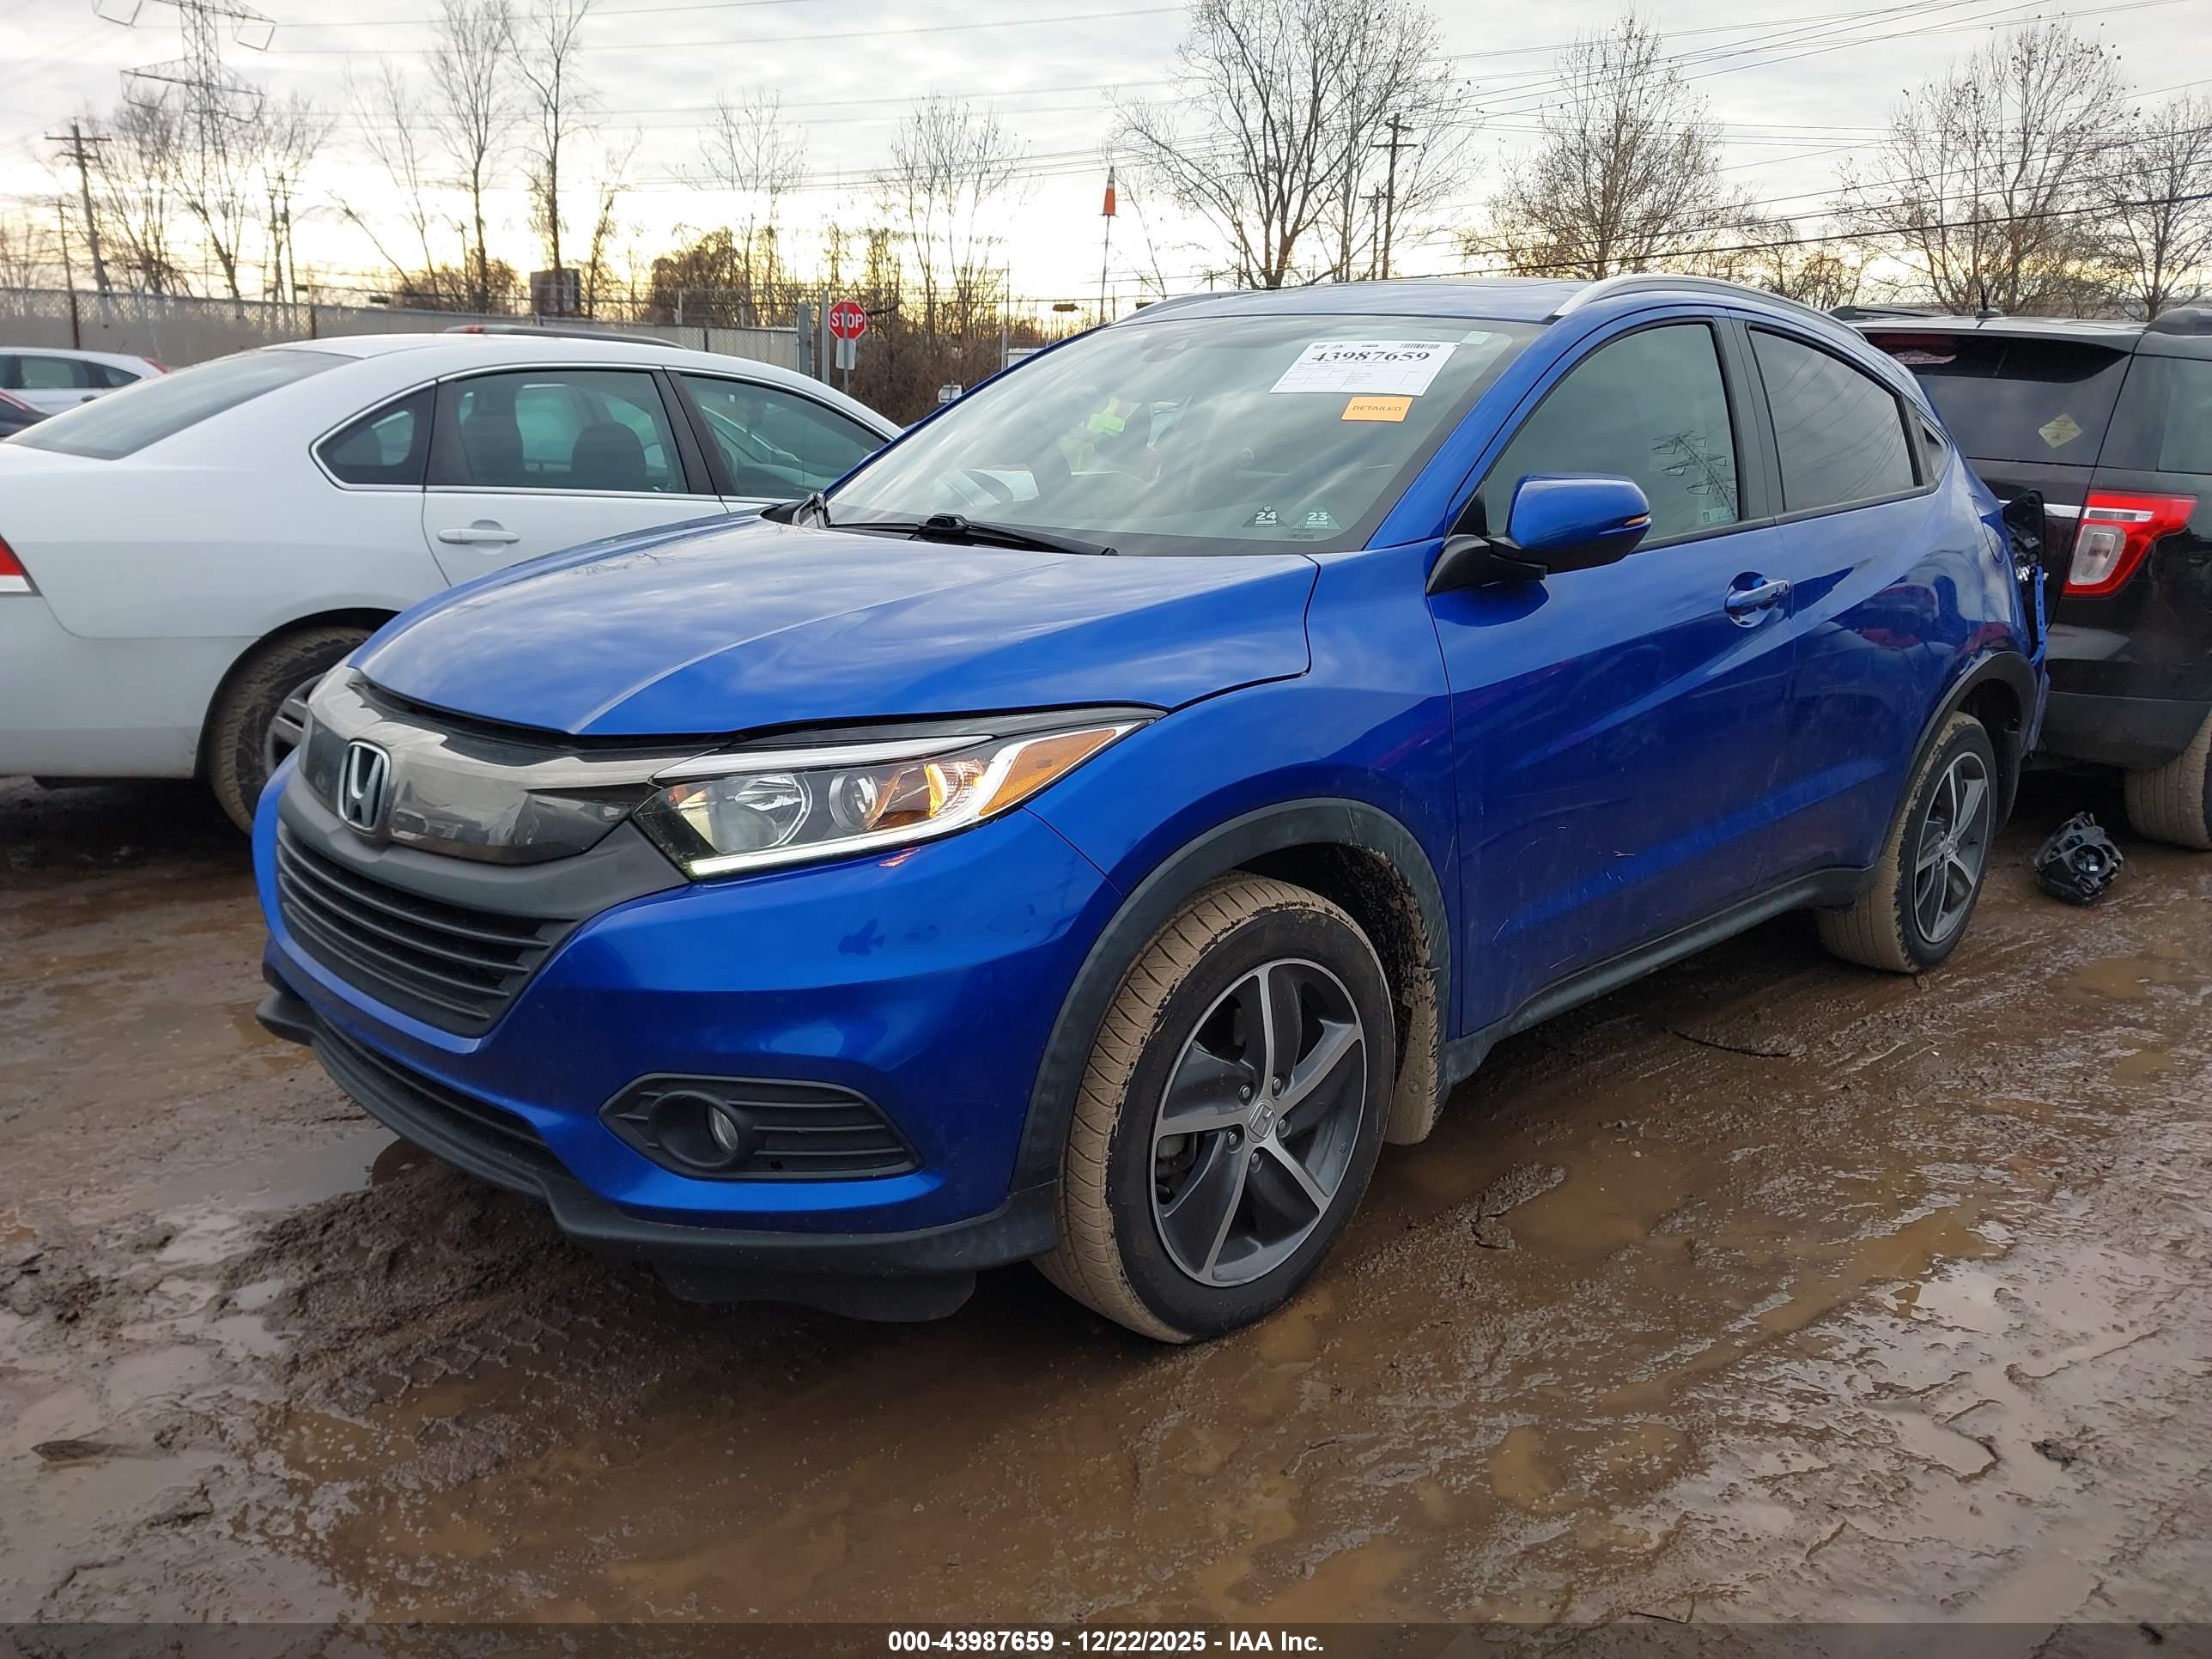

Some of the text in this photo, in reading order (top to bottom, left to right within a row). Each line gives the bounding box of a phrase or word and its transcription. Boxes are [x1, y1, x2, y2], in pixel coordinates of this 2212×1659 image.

[831, 312, 864, 329] STOP
[1312, 351, 1431, 362] 43987659
[1255, 511, 1278, 520] 24
[1307, 512, 1328, 521] 23
